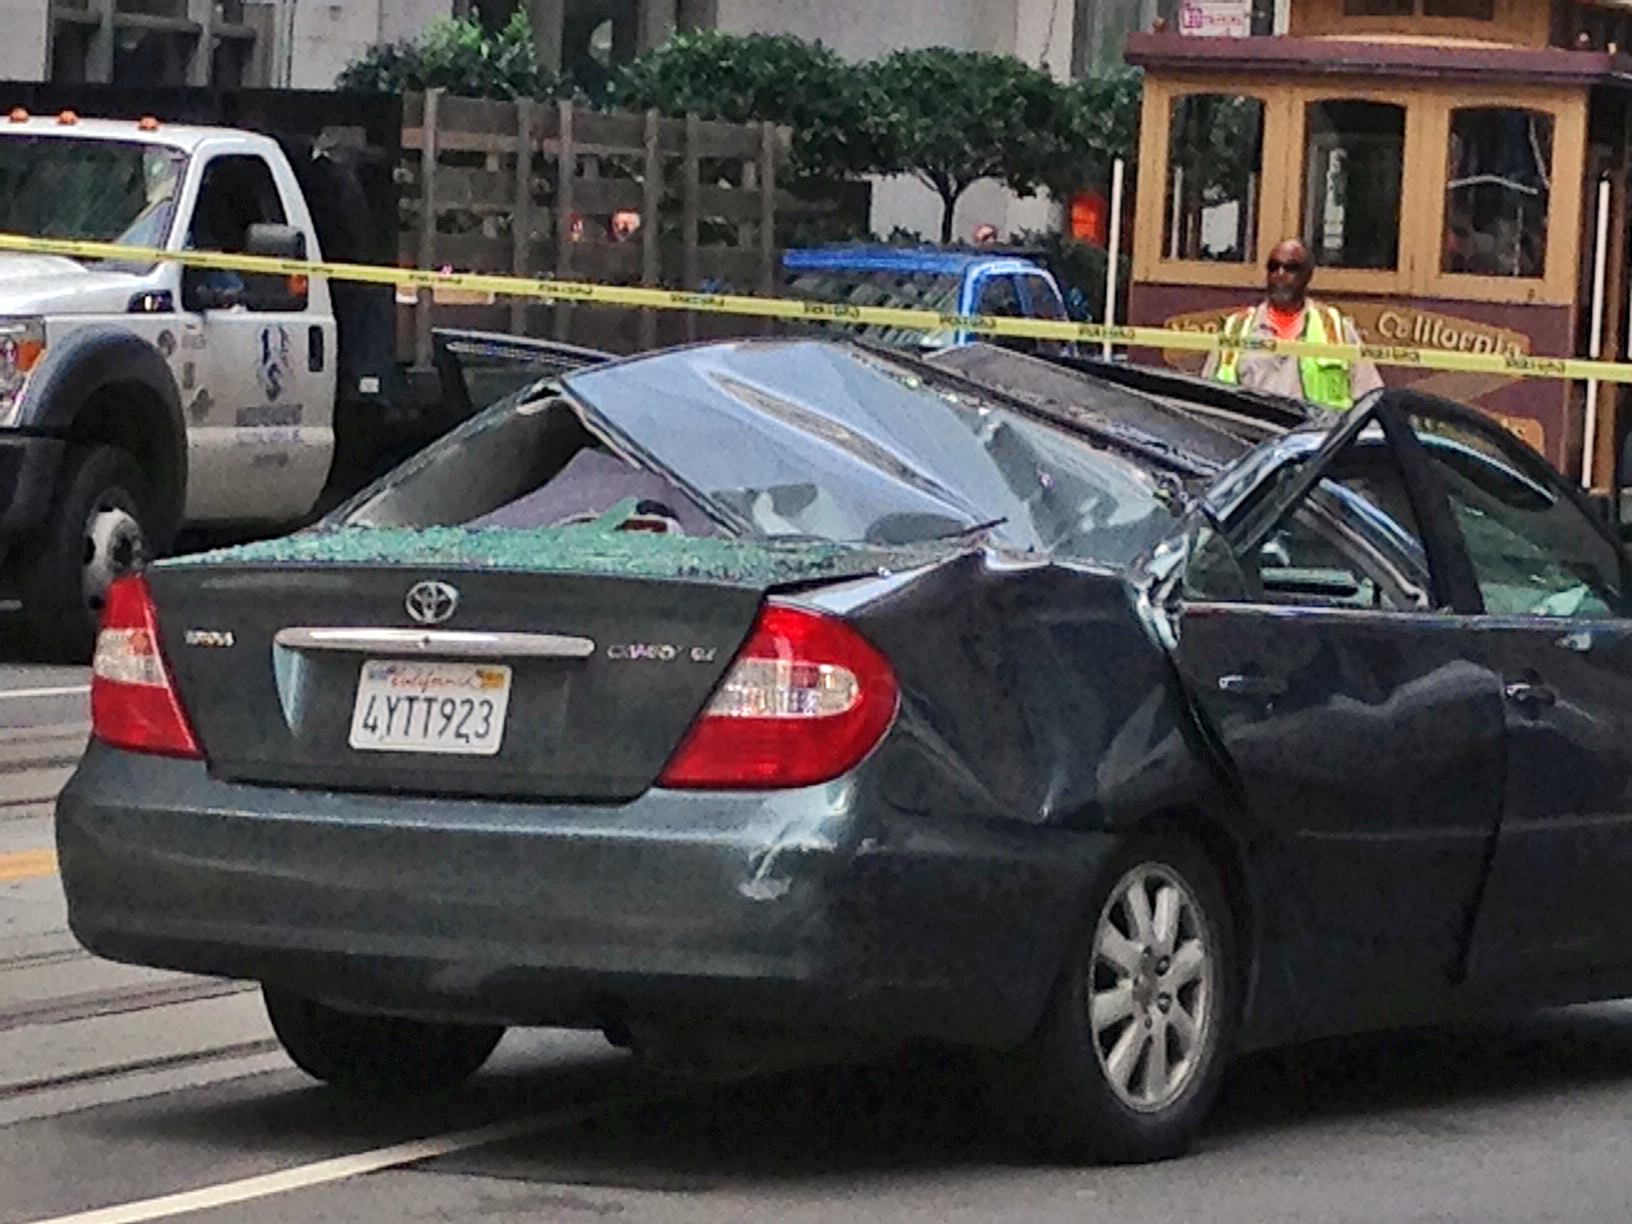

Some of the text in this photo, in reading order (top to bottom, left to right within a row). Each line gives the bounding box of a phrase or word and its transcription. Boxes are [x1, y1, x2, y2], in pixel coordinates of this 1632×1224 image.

[1377, 310, 1524, 360] California
[389, 668, 480, 693] California
[362, 694, 494, 744] 4YTT923
